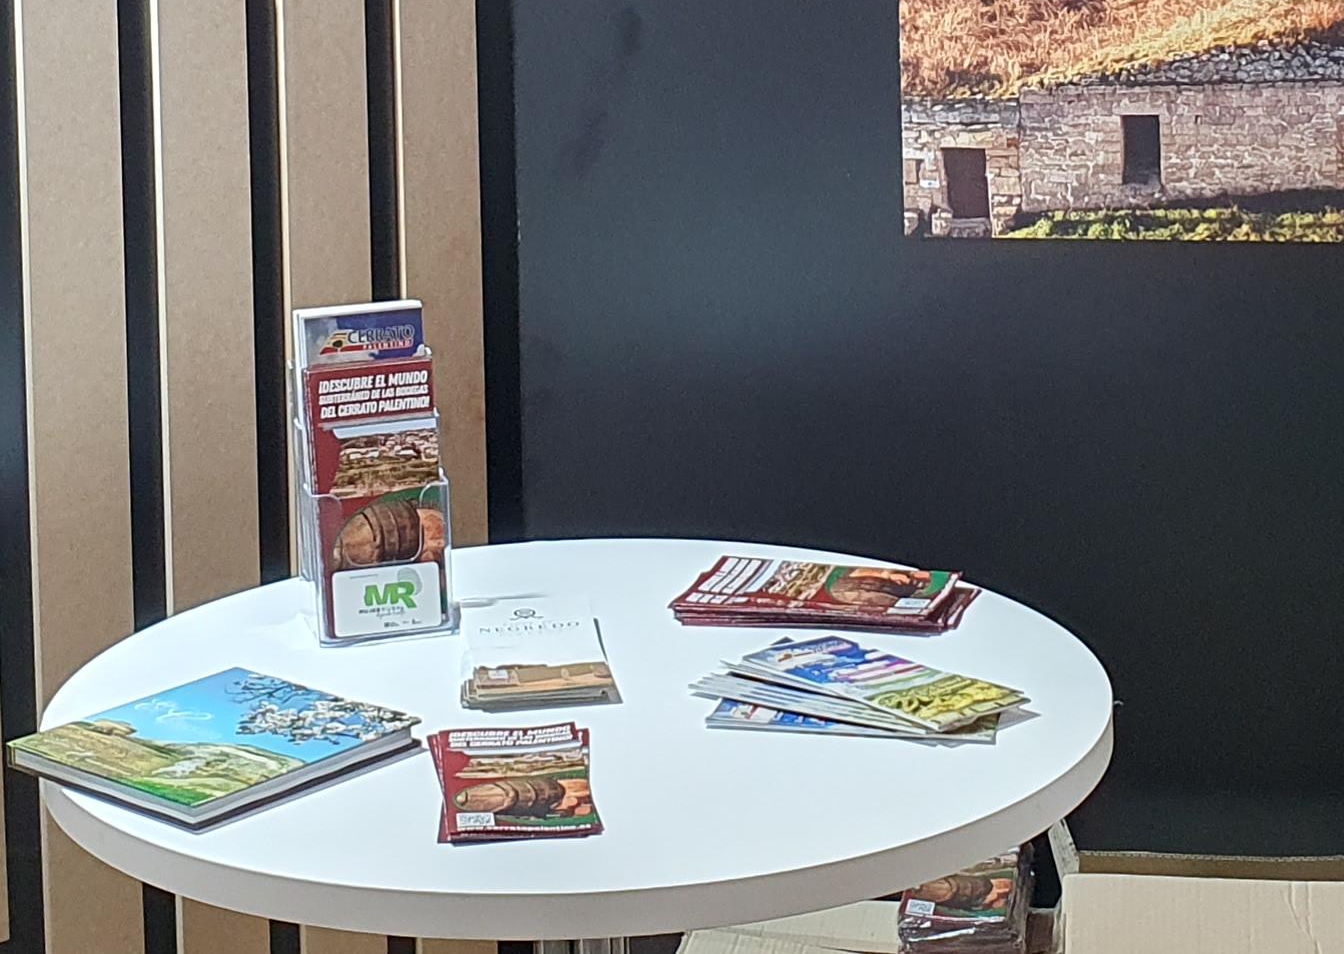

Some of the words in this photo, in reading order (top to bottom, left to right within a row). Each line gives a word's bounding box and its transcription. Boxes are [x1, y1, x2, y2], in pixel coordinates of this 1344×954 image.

[348, 325, 415, 344] CERRATO
[375, 375, 386, 387] EL
[388, 370, 428, 386] MUNDO
[371, 389, 380, 399] DE
[382, 388, 395, 398] LAS
[320, 406, 337, 419] DEL
[338, 402, 377, 416] CERRATO
[378, 396, 430, 413] PALENTINO!
[364, 581, 417, 608] MR
[480, 621, 580, 634] NEGREDO
